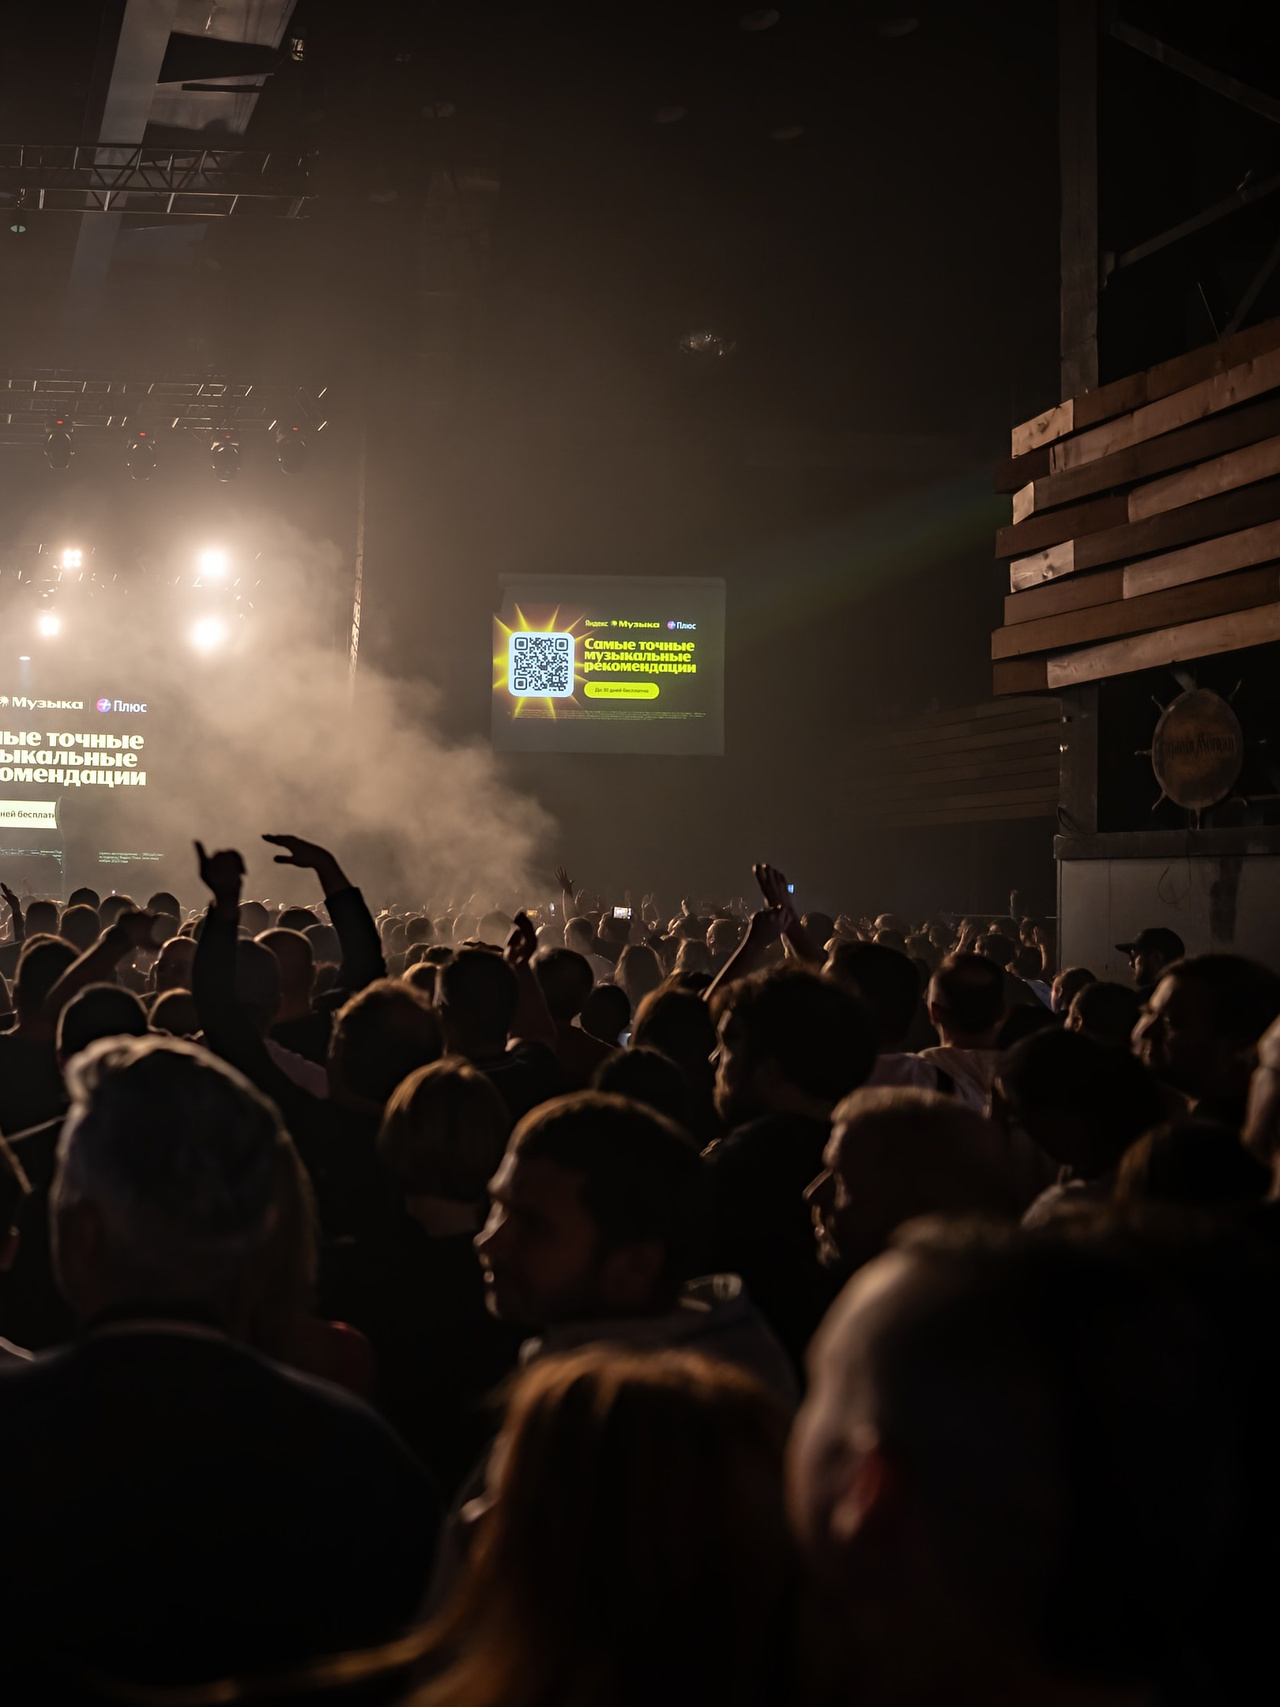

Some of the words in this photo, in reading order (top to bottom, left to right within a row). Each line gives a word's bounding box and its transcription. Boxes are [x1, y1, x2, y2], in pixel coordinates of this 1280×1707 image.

[618, 620, 661, 629] Музыка
[676, 621, 697, 630] Плюс
[584, 637, 637, 650] Самые
[638, 641, 695, 652] точные
[584, 651, 692, 663] музыкальные
[584, 661, 697, 674] рекомендации
[12, 696, 84, 710] Музыка
[113, 700, 147, 713] Плюс
[46, 732, 145, 750] точные
